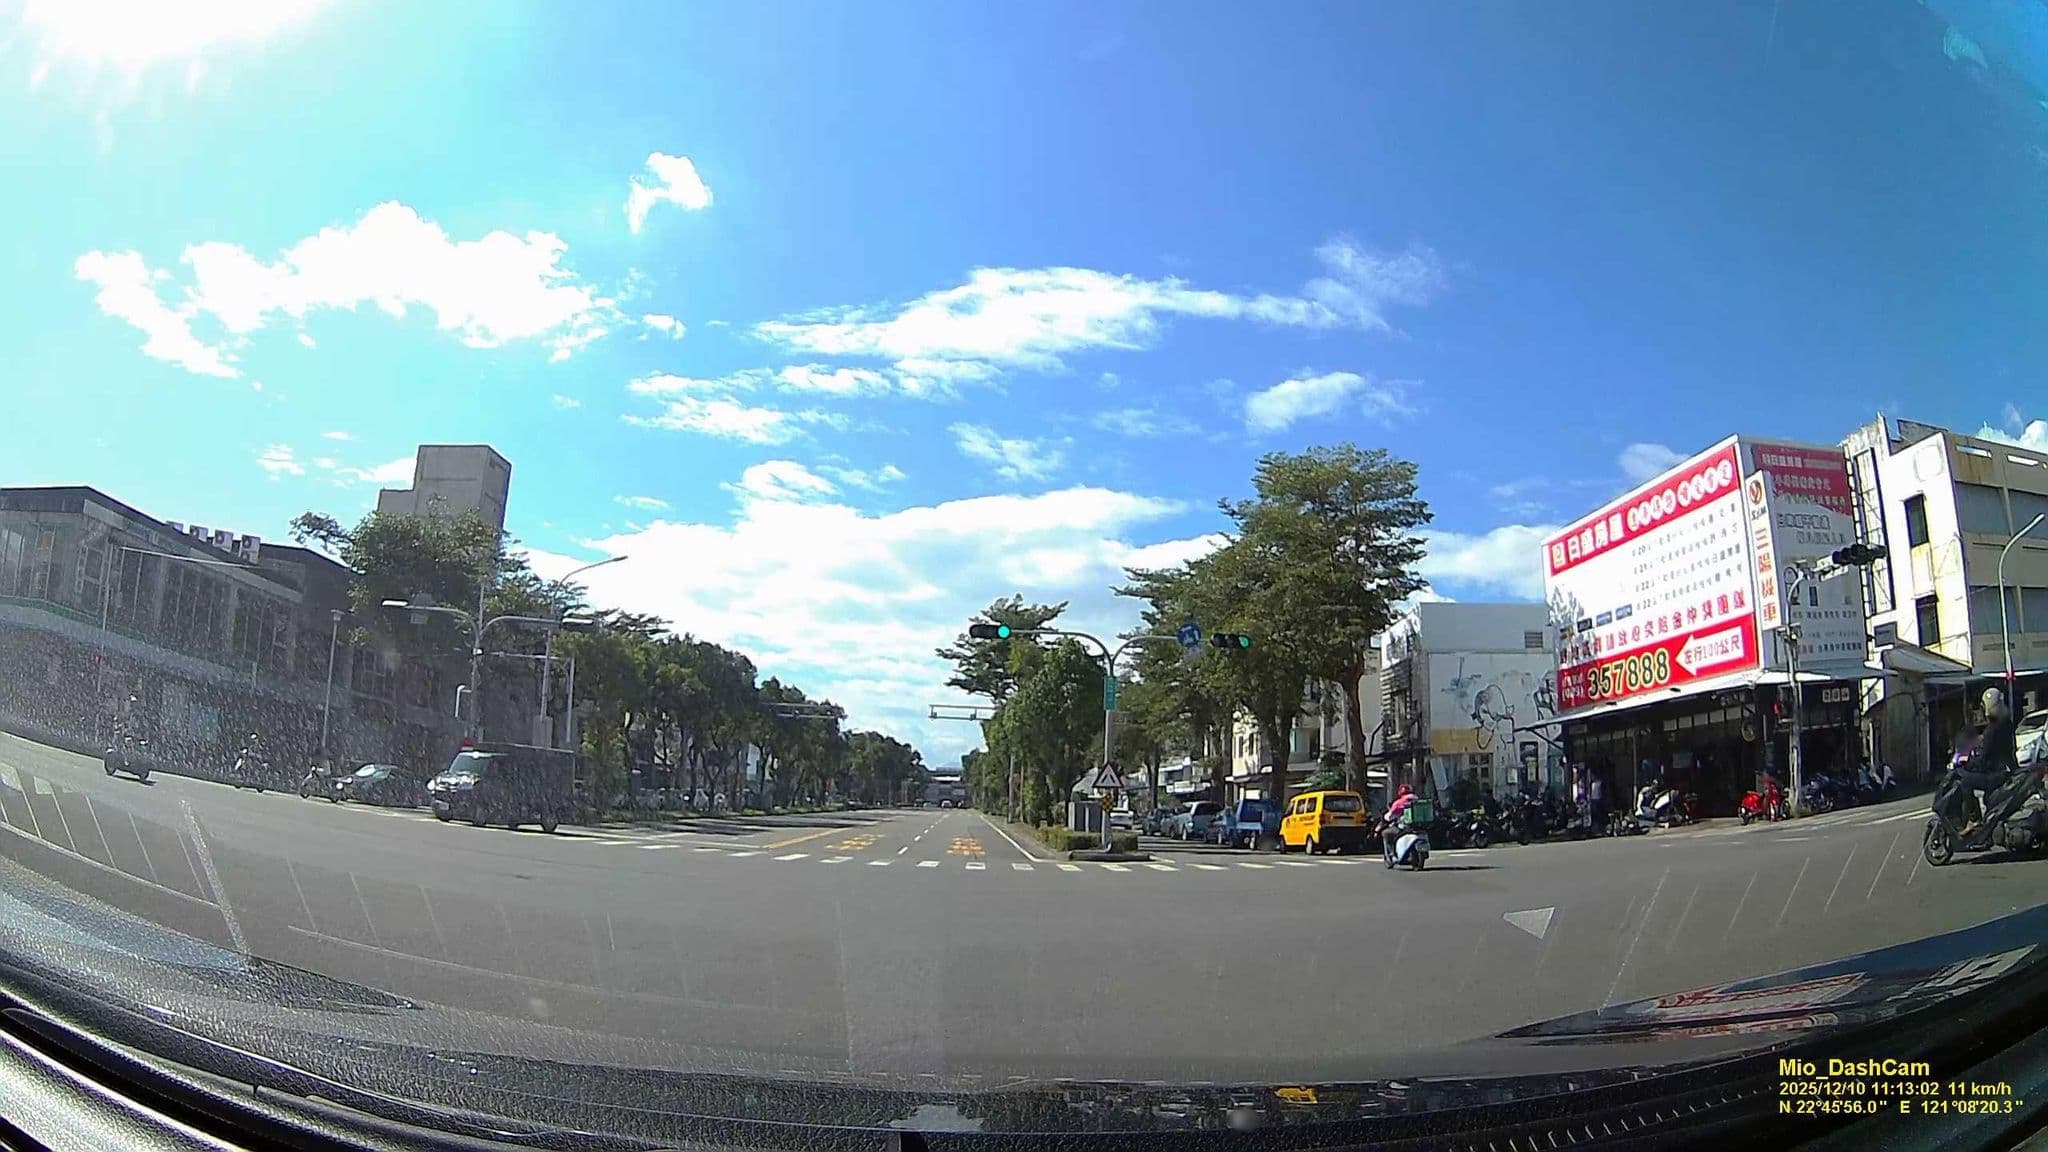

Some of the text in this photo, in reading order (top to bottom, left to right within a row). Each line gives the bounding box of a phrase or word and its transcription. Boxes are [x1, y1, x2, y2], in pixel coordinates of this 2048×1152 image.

[1755, 528, 1777, 622] 三陽機車
[1588, 651, 1669, 698] 357888
